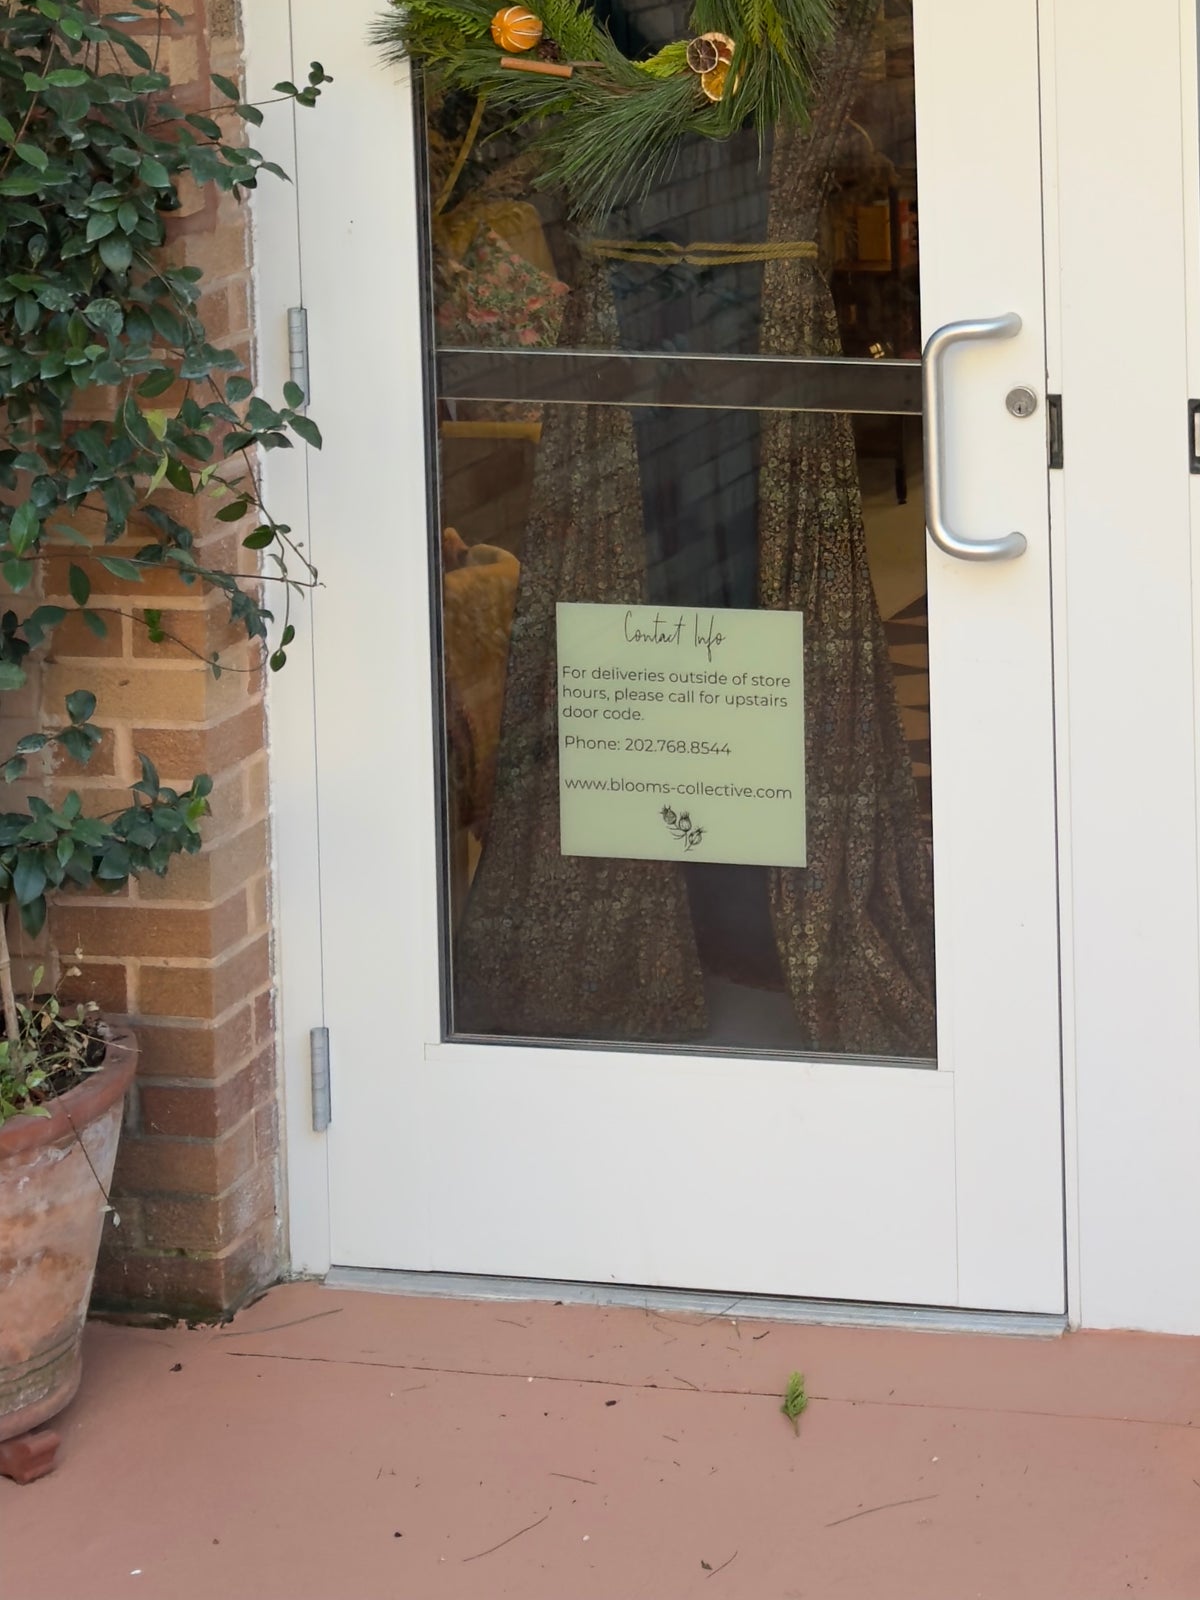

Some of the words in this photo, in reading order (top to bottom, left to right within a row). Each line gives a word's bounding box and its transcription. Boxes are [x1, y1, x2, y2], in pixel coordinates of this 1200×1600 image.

[624, 610, 686, 645] Contact
[694, 612, 727, 663] Info
[562, 665, 587, 680] For
[591, 666, 666, 683] deliveries
[668, 670, 728, 686] outside
[731, 672, 749, 686] of
[750, 674, 791, 688] store
[562, 684, 610, 702] hours,
[614, 687, 665, 703] please
[668, 689, 695, 704] call
[698, 690, 721, 705] for
[724, 694, 788, 709] upstairs
[562, 704, 599, 719] door
[602, 706, 645, 721] code.
[564, 735, 621, 751] Phone:
[624, 737, 732, 756] 202.768.8544
[564, 777, 793, 800] www.blooms-collective.com
